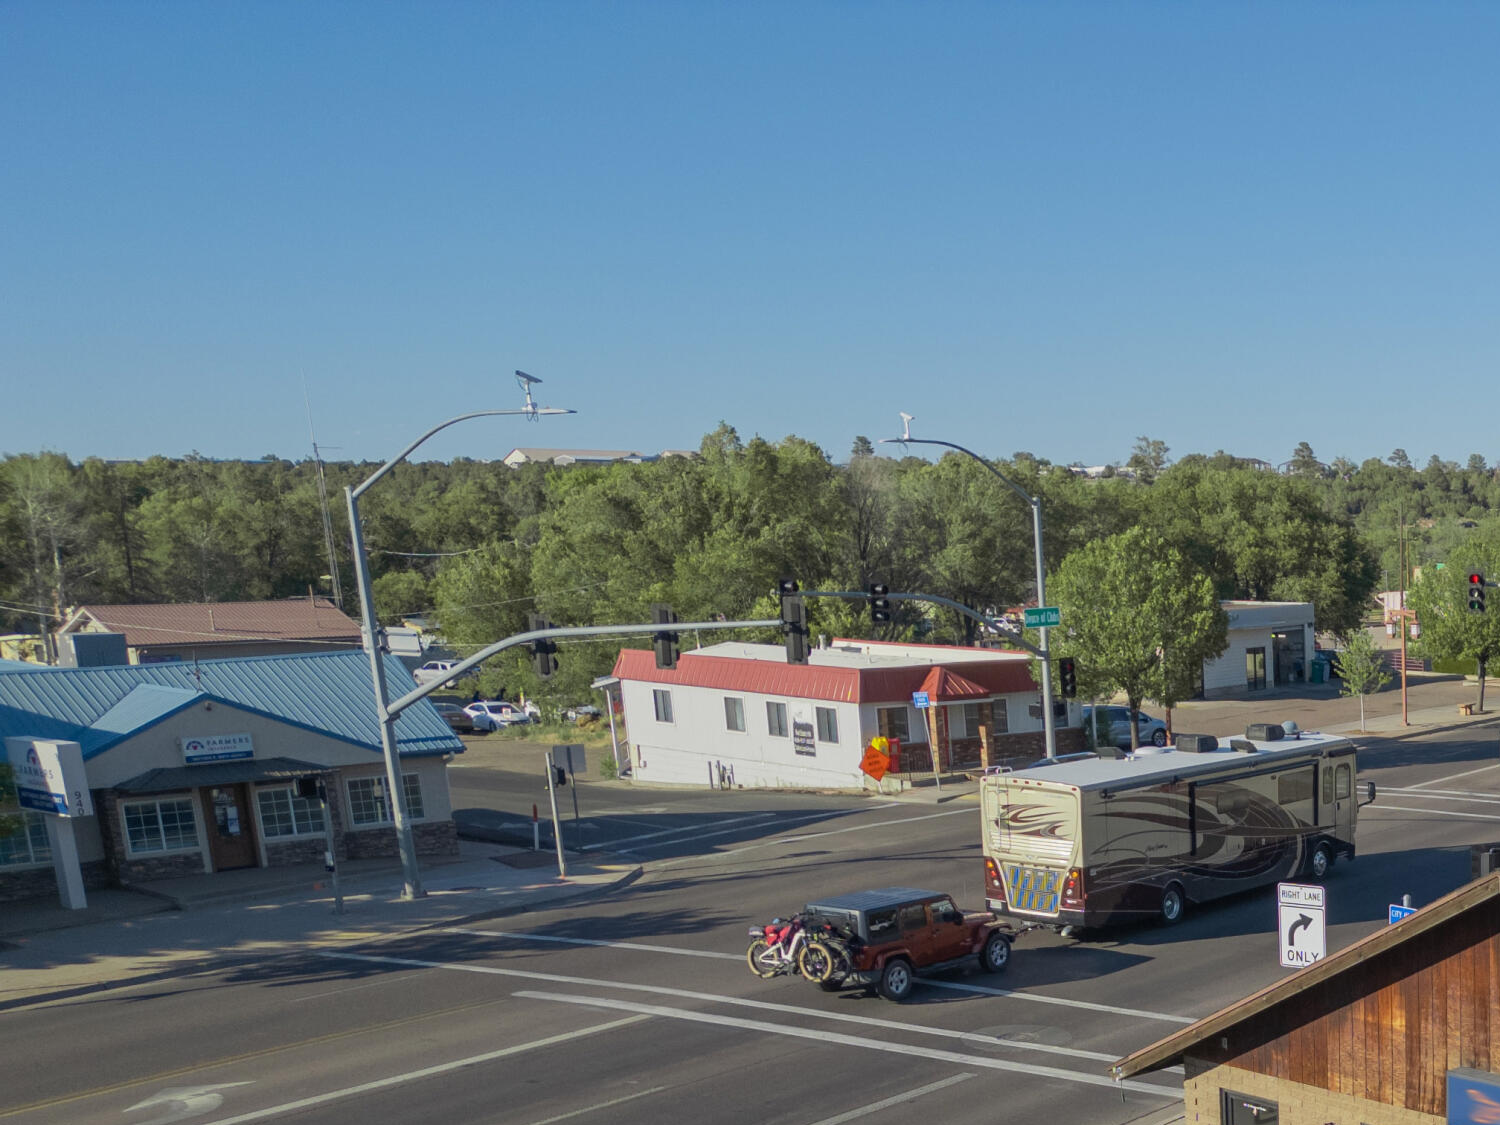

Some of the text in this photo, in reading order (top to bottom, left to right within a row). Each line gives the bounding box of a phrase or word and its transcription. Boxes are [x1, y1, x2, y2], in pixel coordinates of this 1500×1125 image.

[206, 737, 249, 746] FARMERS
[1281, 889, 1321, 902] RIGHT LANE
[1391, 910, 1402, 918] CITY
[1287, 949, 1319, 963] ONLY
